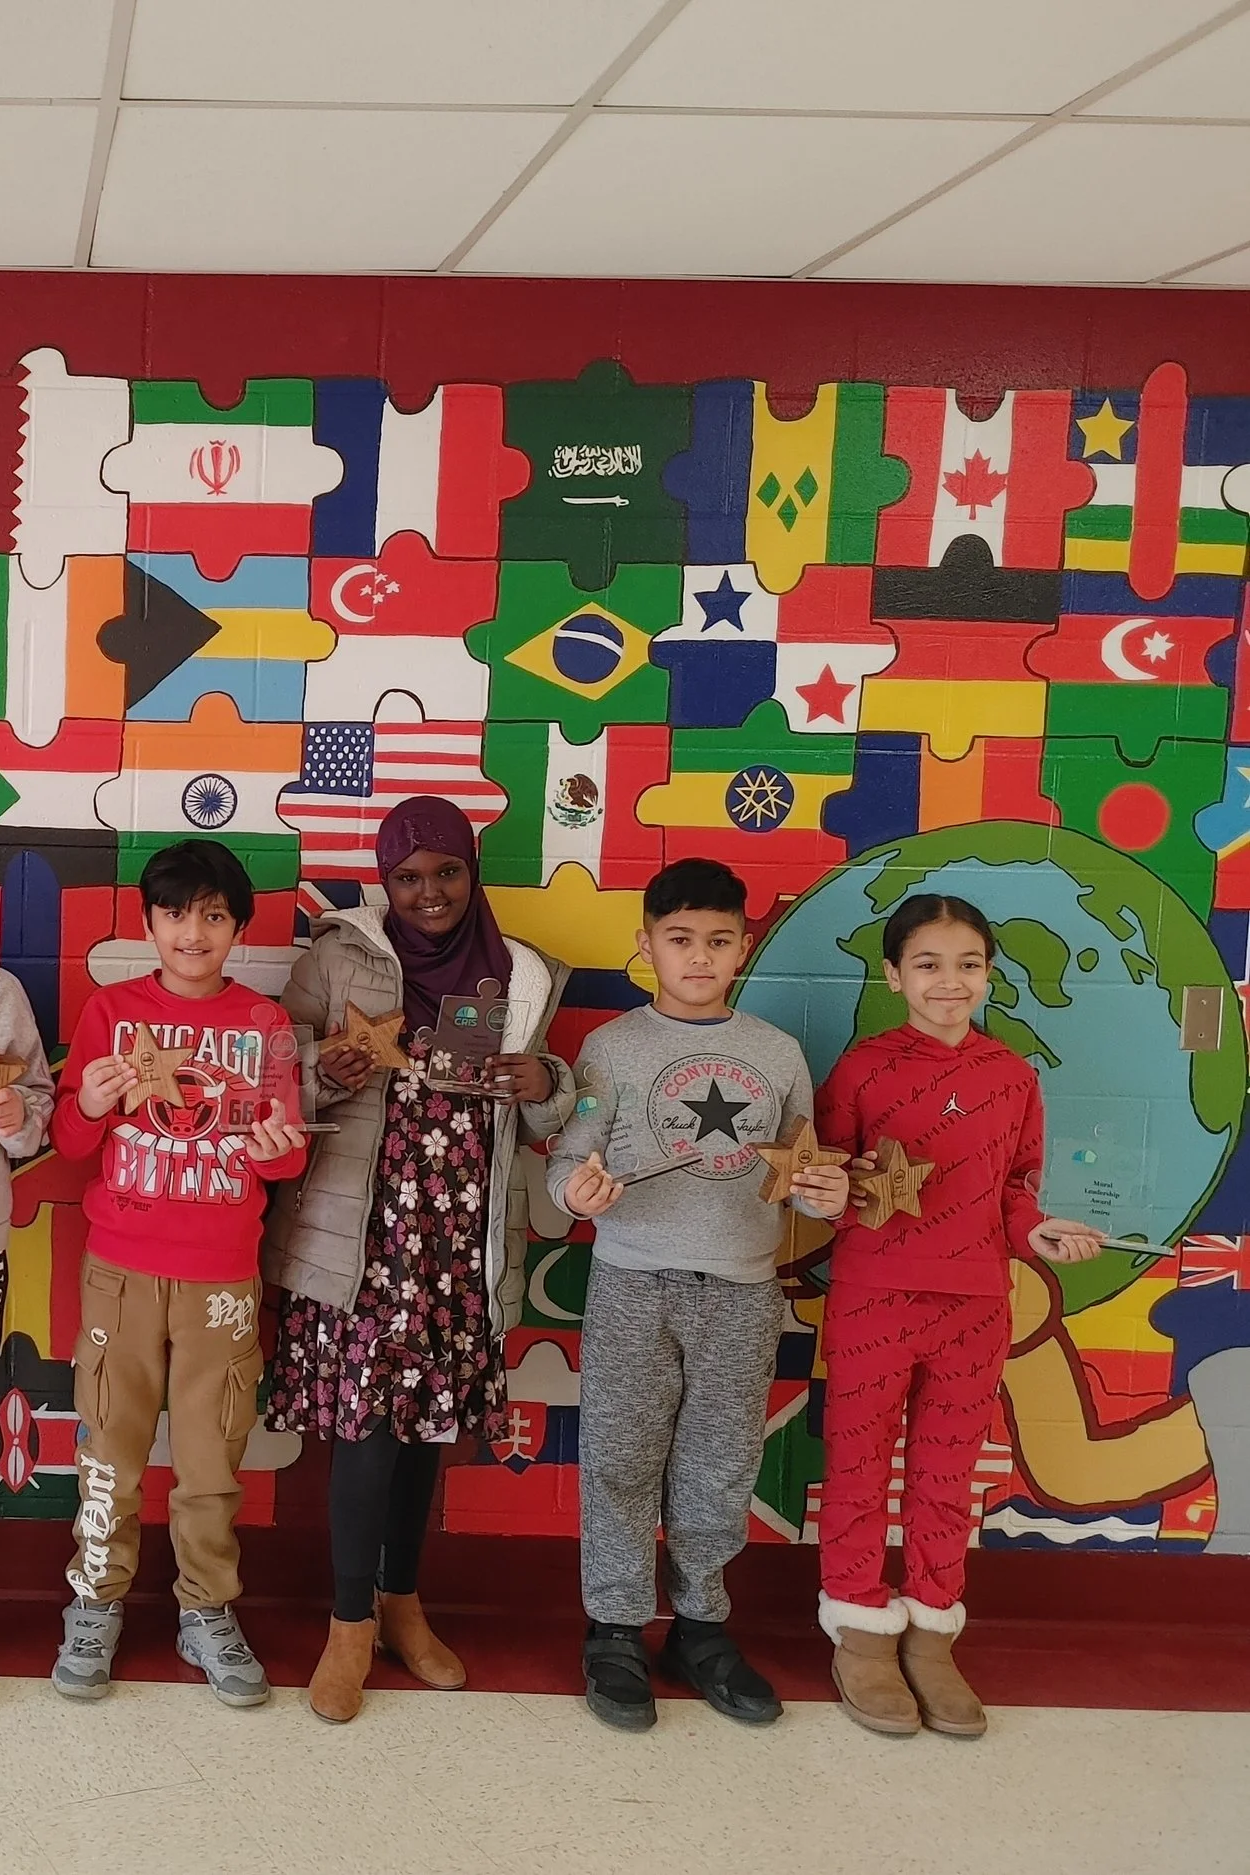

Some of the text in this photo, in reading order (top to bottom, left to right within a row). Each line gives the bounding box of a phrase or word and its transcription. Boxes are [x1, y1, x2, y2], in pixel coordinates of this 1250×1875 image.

[454, 1017, 478, 1027] CRIS
[664, 1062, 765, 1100] CONVERSE
[661, 1116, 698, 1130] Chuck
[106, 1123, 252, 1206] BULLS
[1084, 1188, 1121, 1199] Leadership
[1090, 1197, 1112, 1206] Award
